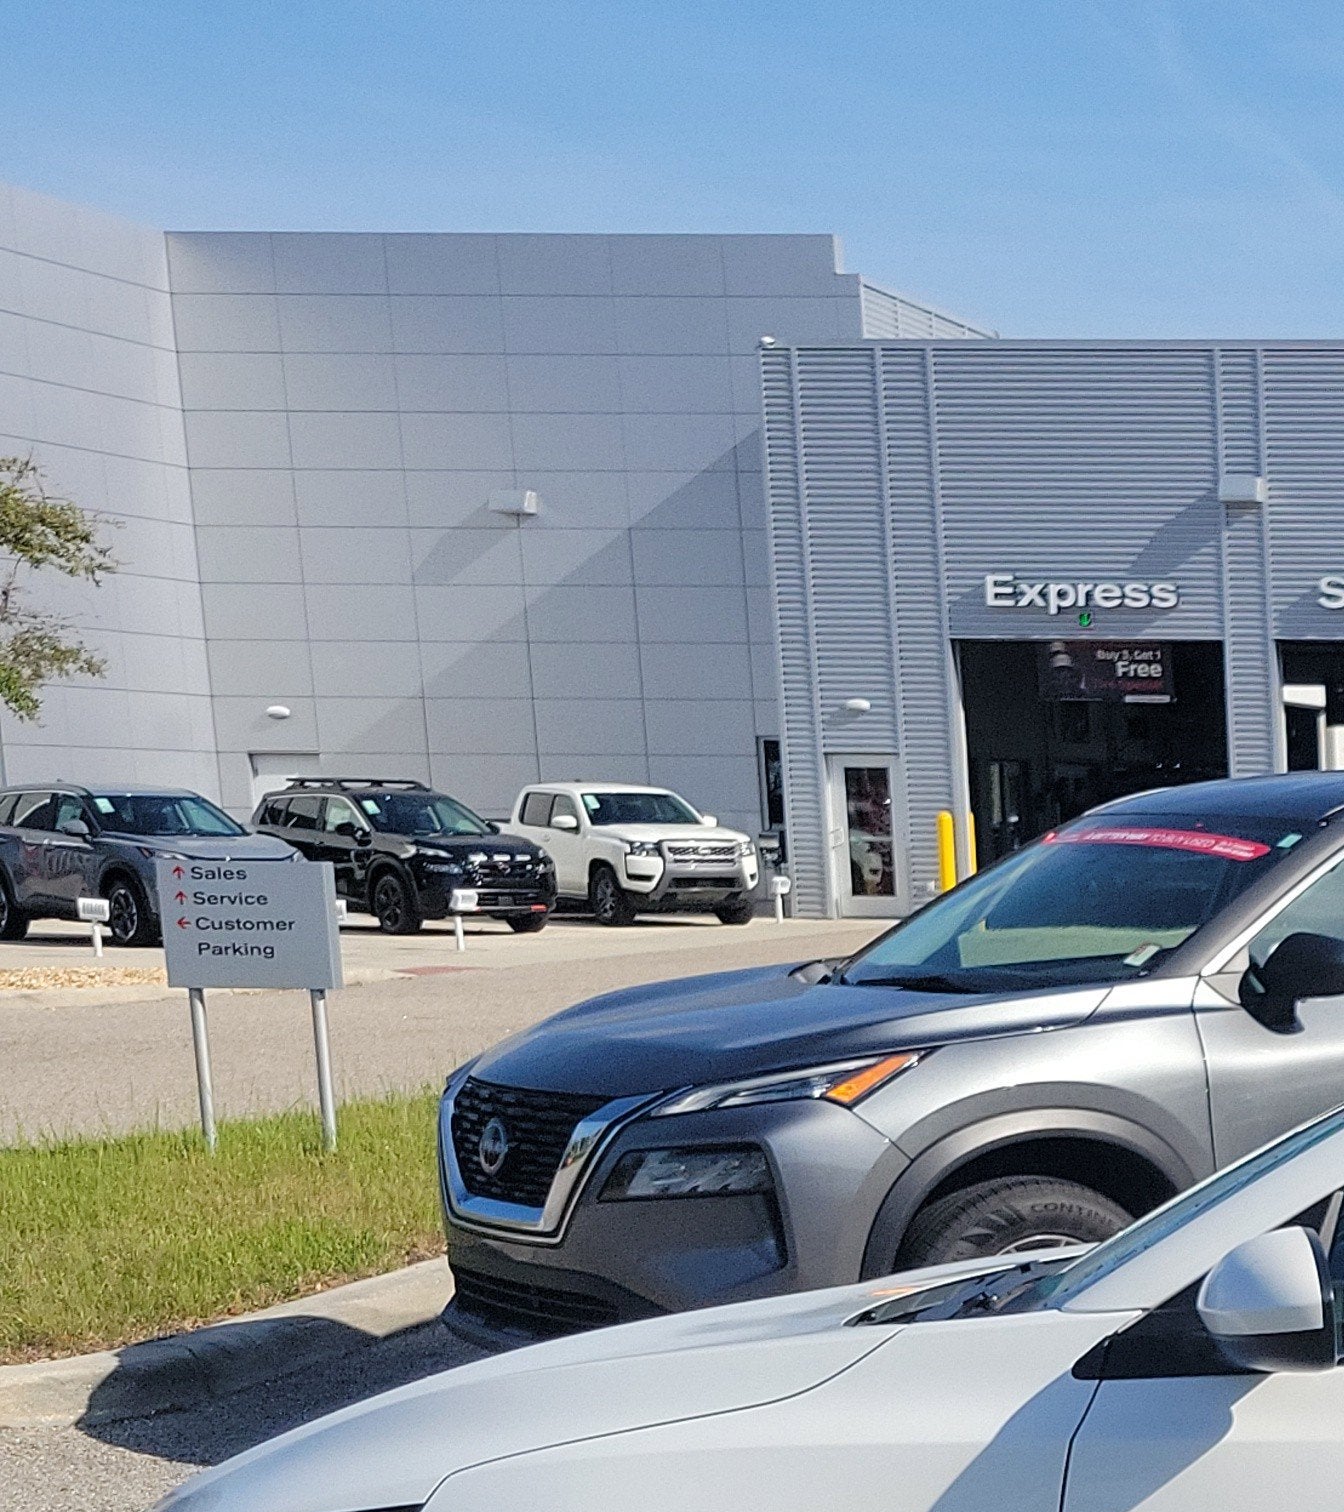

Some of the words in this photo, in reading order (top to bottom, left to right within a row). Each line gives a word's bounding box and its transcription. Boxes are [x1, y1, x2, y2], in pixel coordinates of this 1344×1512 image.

[985, 574, 1179, 615] Express
[1115, 661, 1163, 677] Free
[190, 866, 247, 880] Sales
[193, 891, 268, 905] Service
[195, 917, 296, 931] Customer
[198, 942, 275, 959] Parking
